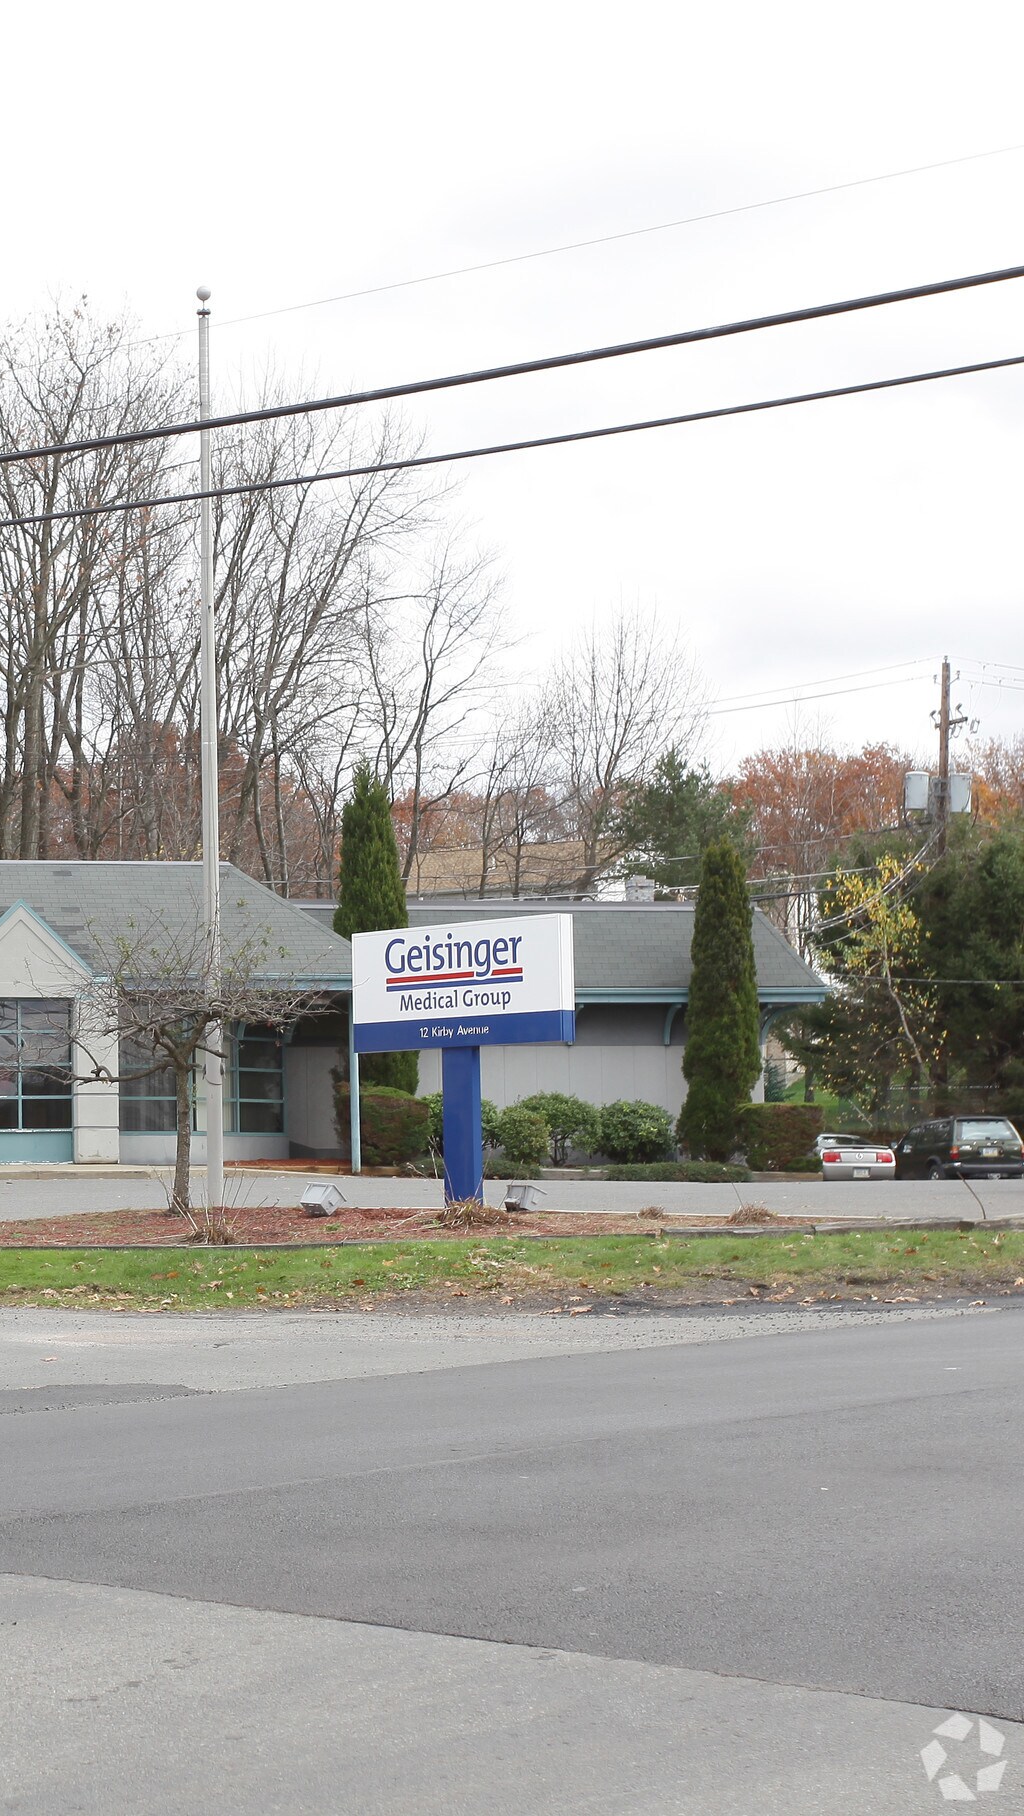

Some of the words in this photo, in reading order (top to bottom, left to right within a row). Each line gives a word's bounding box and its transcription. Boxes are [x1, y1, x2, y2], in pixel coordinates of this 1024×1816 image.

[384, 932, 522, 977] Geisinger
[399, 990, 458, 1012] Medical
[462, 990, 511, 1010] Group
[419, 1026, 429, 1038] 12
[431, 1025, 454, 1039] Kirby
[456, 1024, 489, 1036] Avenue
